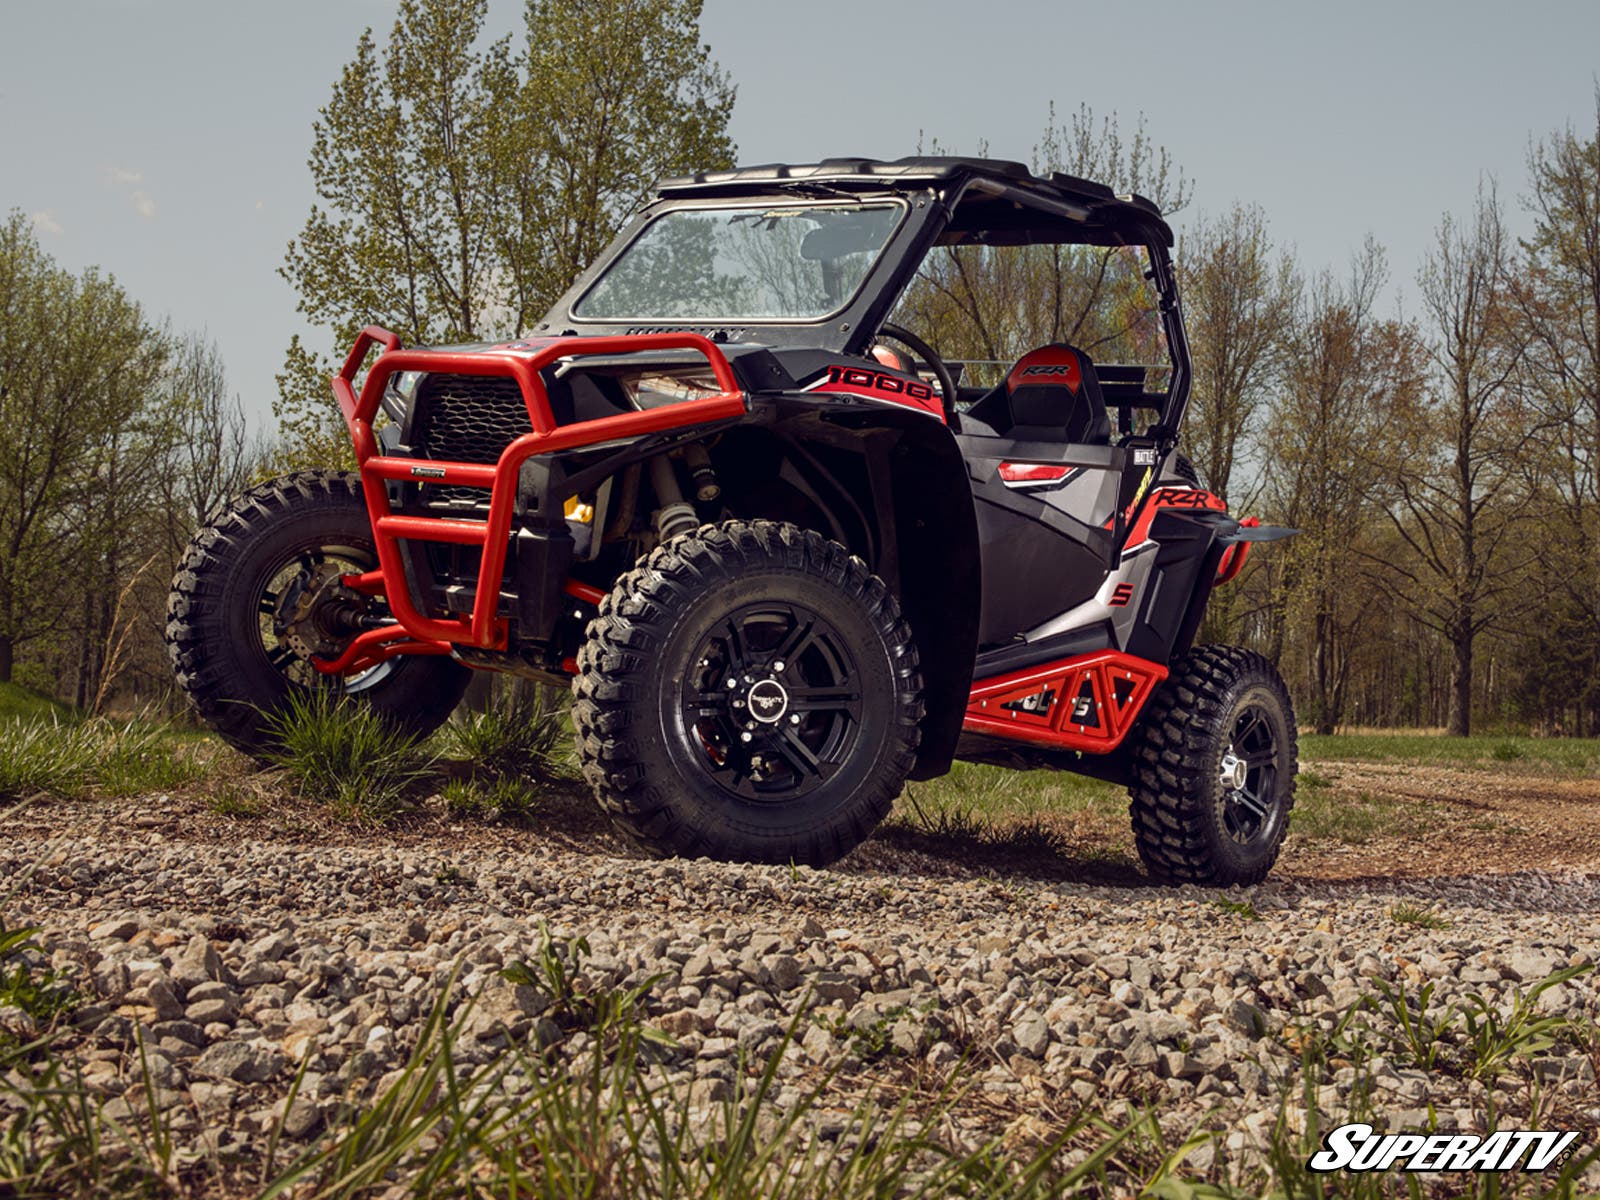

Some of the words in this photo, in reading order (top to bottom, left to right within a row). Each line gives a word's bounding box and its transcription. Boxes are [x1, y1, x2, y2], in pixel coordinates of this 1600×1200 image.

[1022, 365, 1070, 377] RZR
[829, 366, 932, 400] 1000
[1154, 488, 1209, 507] RZR
[1108, 583, 1134, 607] S
